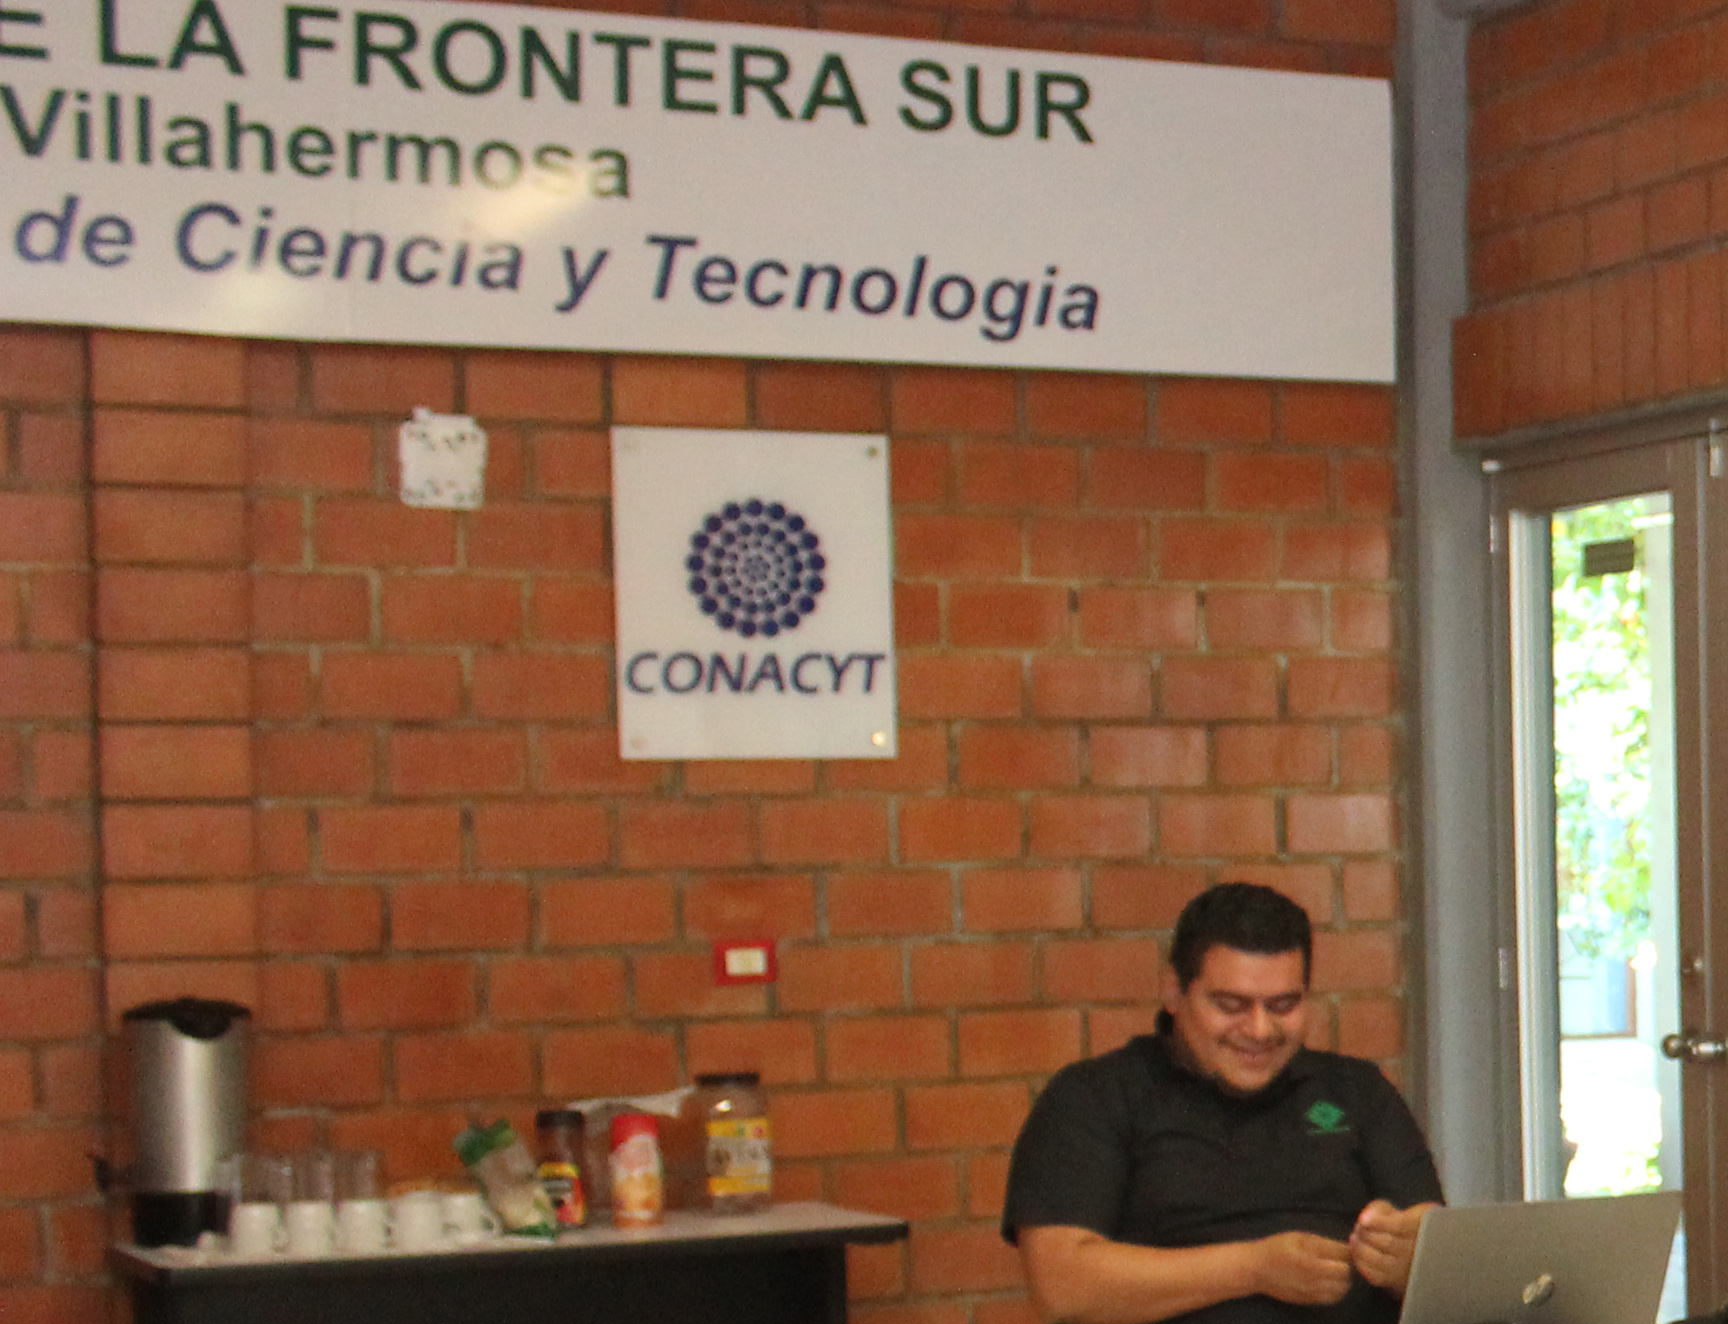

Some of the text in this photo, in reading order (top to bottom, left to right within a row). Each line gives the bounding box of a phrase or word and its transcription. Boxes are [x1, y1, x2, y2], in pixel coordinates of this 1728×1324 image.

[99, 0, 245, 76] LA
[284, 5, 868, 126] FRONTERA
[899, 60, 1095, 145] SUR
[0, 84, 632, 199] Villahermosa
[16, 195, 1099, 342] de Ciencia y Tecnologia
[624, 651, 885, 694] CONACYT
